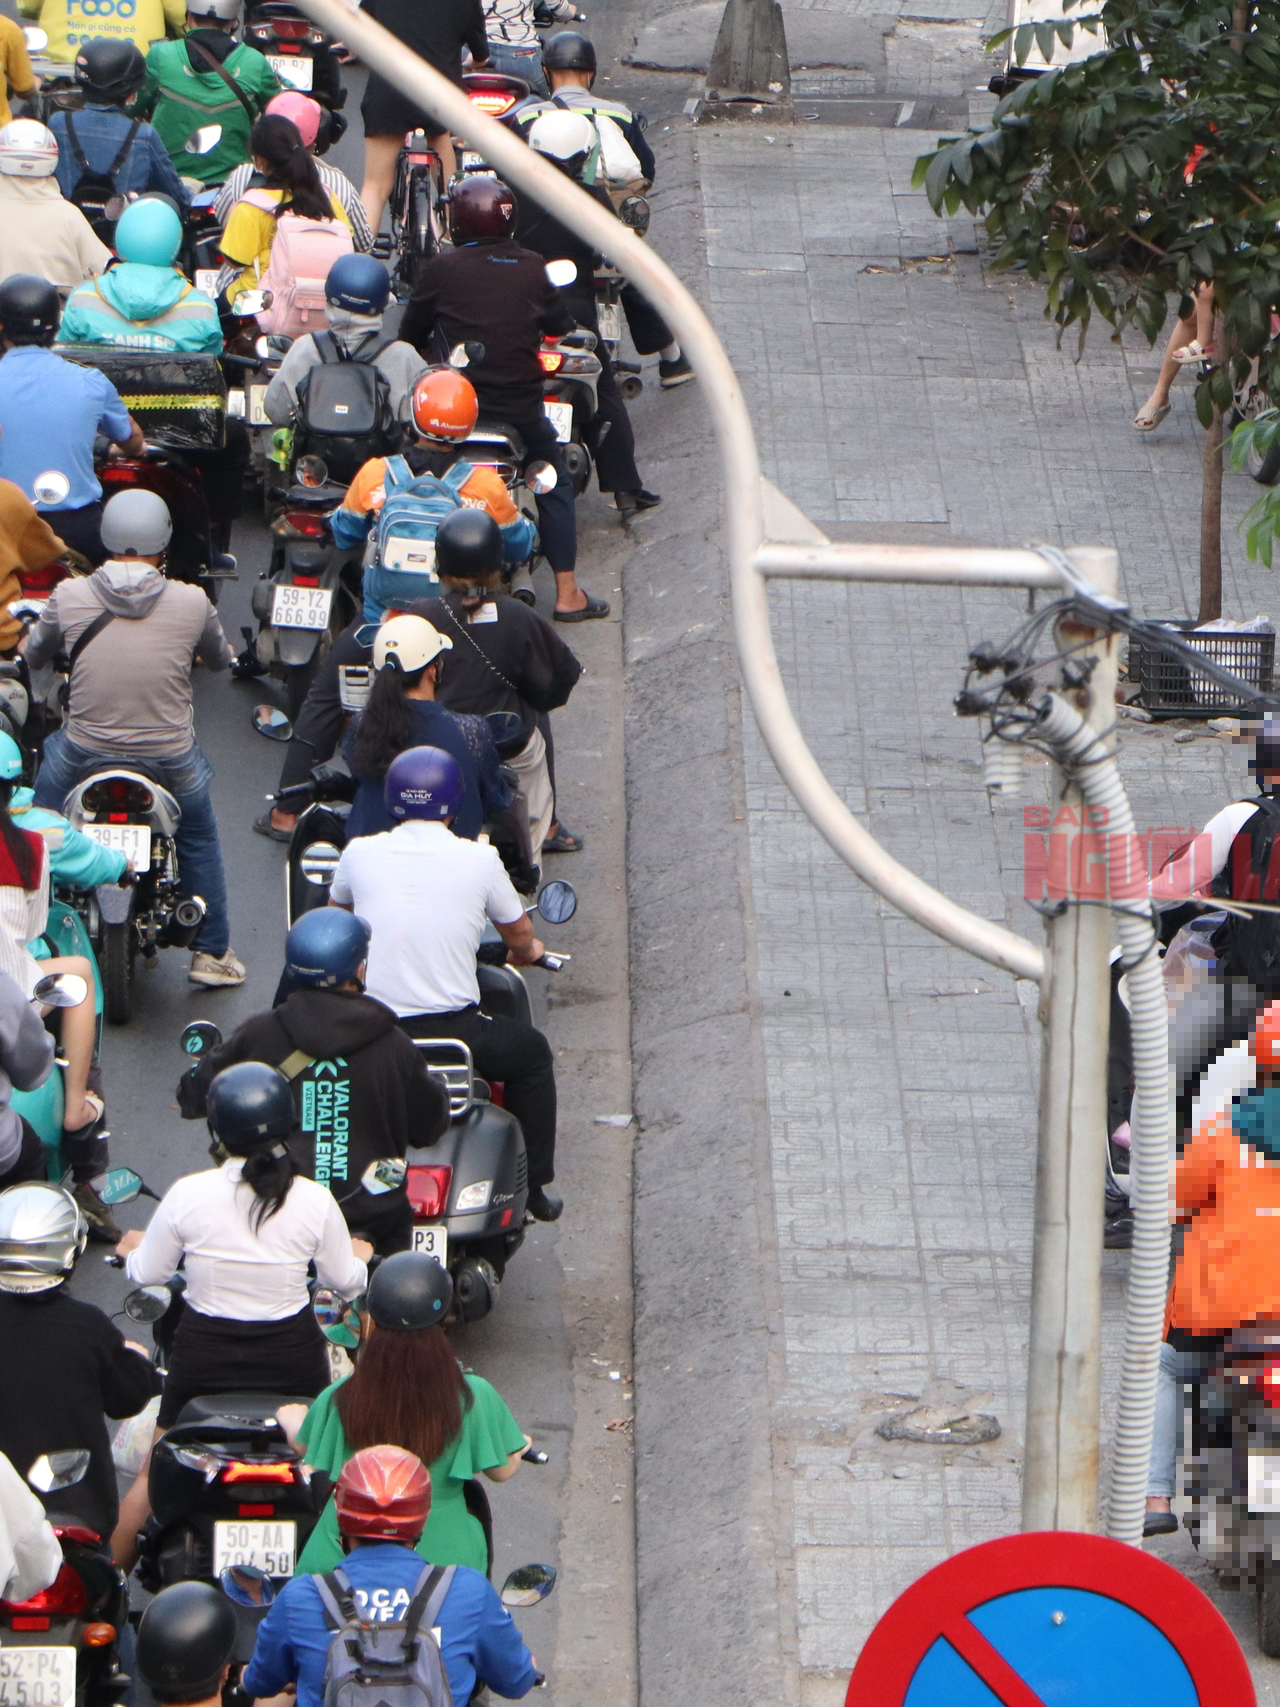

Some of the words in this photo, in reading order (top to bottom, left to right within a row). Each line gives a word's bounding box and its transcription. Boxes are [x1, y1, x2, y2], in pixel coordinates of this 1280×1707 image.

[282, 587, 325, 608] 59-Y2
[274, 606, 328, 627] 666.99
[94, 828, 140, 848] 39-F1
[305, 1086, 313, 1126] VIETNAM
[331, 1079, 350, 1181] VALORANT
[226, 1525, 283, 1549] 50-AA
[0, 1652, 62, 1678] 52-P4
